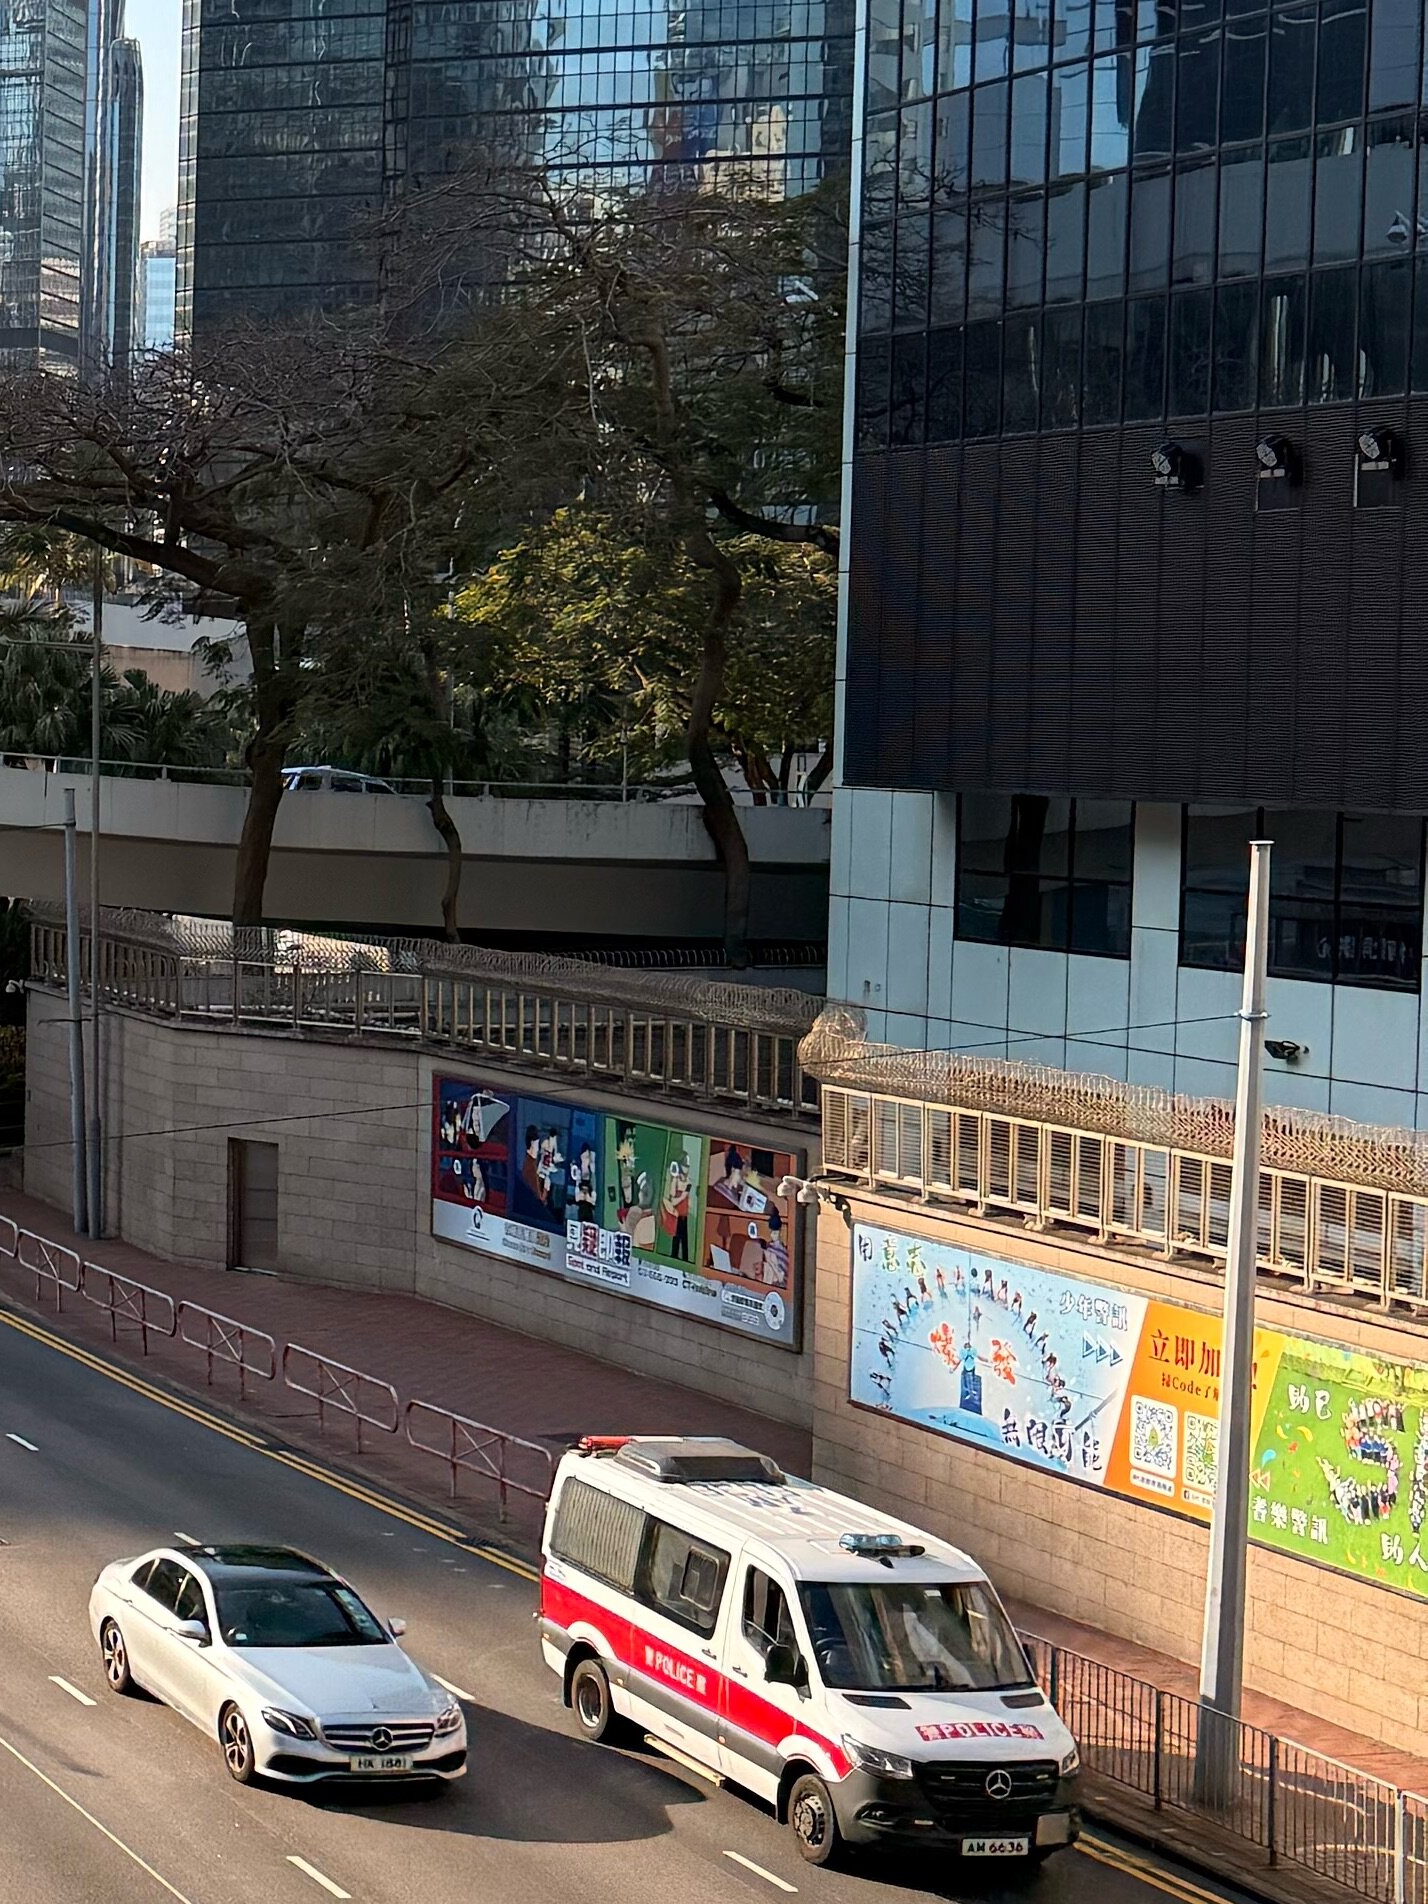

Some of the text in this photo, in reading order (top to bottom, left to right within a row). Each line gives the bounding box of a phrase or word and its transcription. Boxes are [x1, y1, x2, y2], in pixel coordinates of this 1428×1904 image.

[1060, 1291, 1128, 1331] 少年警訊
[1288, 1384, 1332, 1420] 助己
[655, 1650, 695, 1690] POLICE
[939, 1722, 1021, 1740] POLICE
[967, 1841, 1023, 1853] AM 6636
